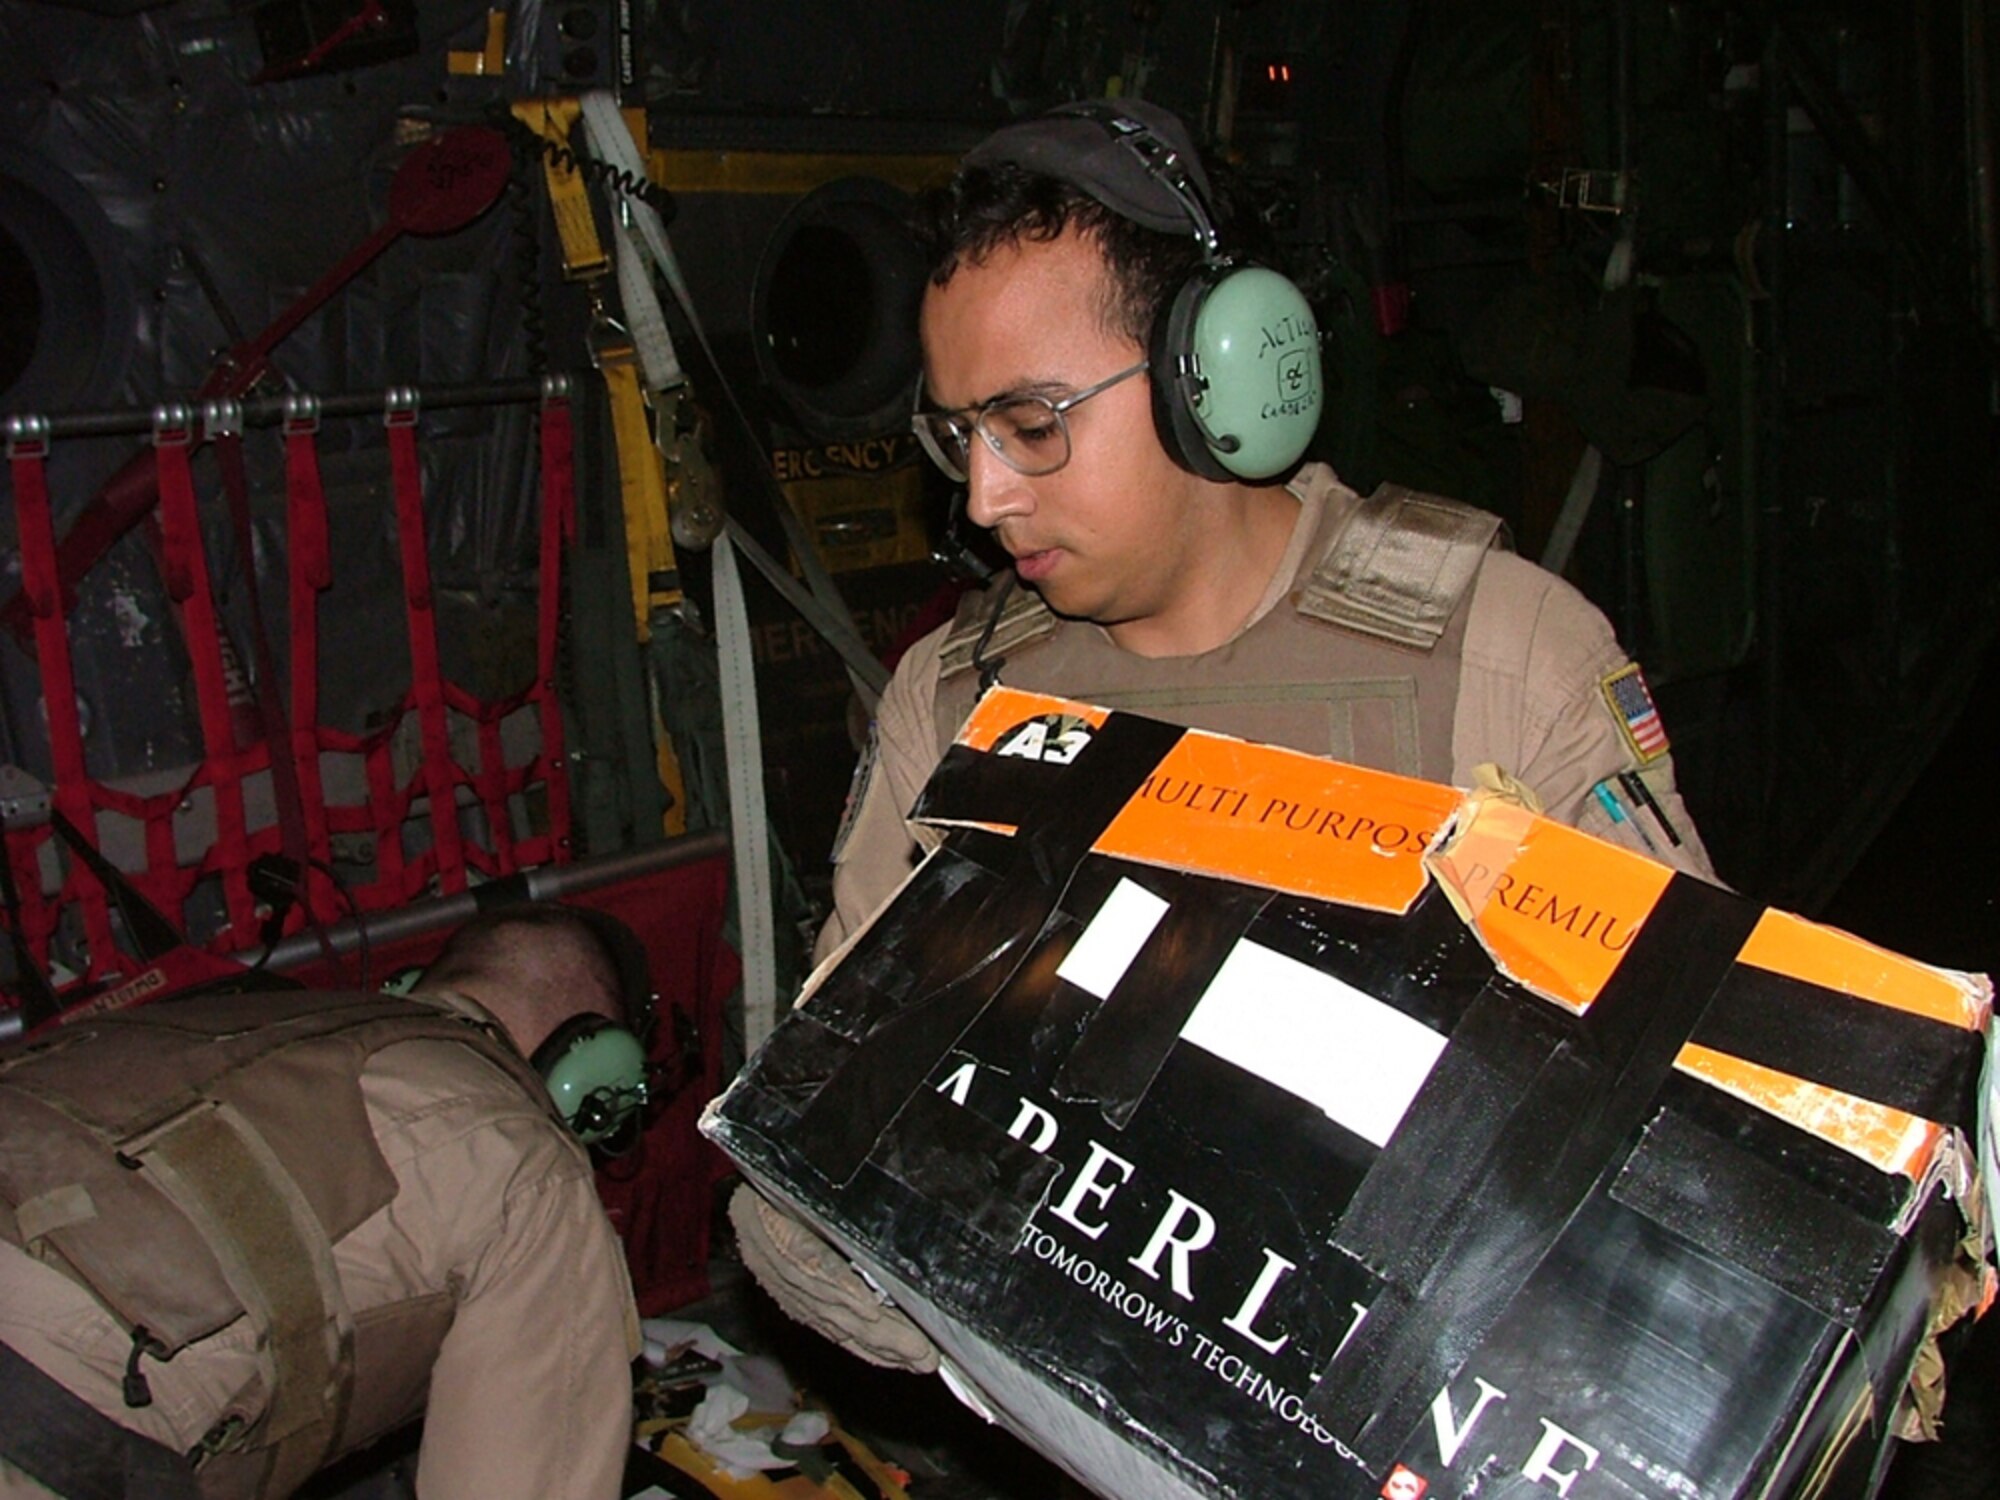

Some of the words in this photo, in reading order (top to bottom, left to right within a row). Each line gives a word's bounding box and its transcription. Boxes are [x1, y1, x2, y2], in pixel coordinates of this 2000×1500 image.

[997, 721, 1092, 765] A3
[1463, 862, 1638, 951] PREMIU
[1020, 1222, 1189, 1347] TOMORROW'S
